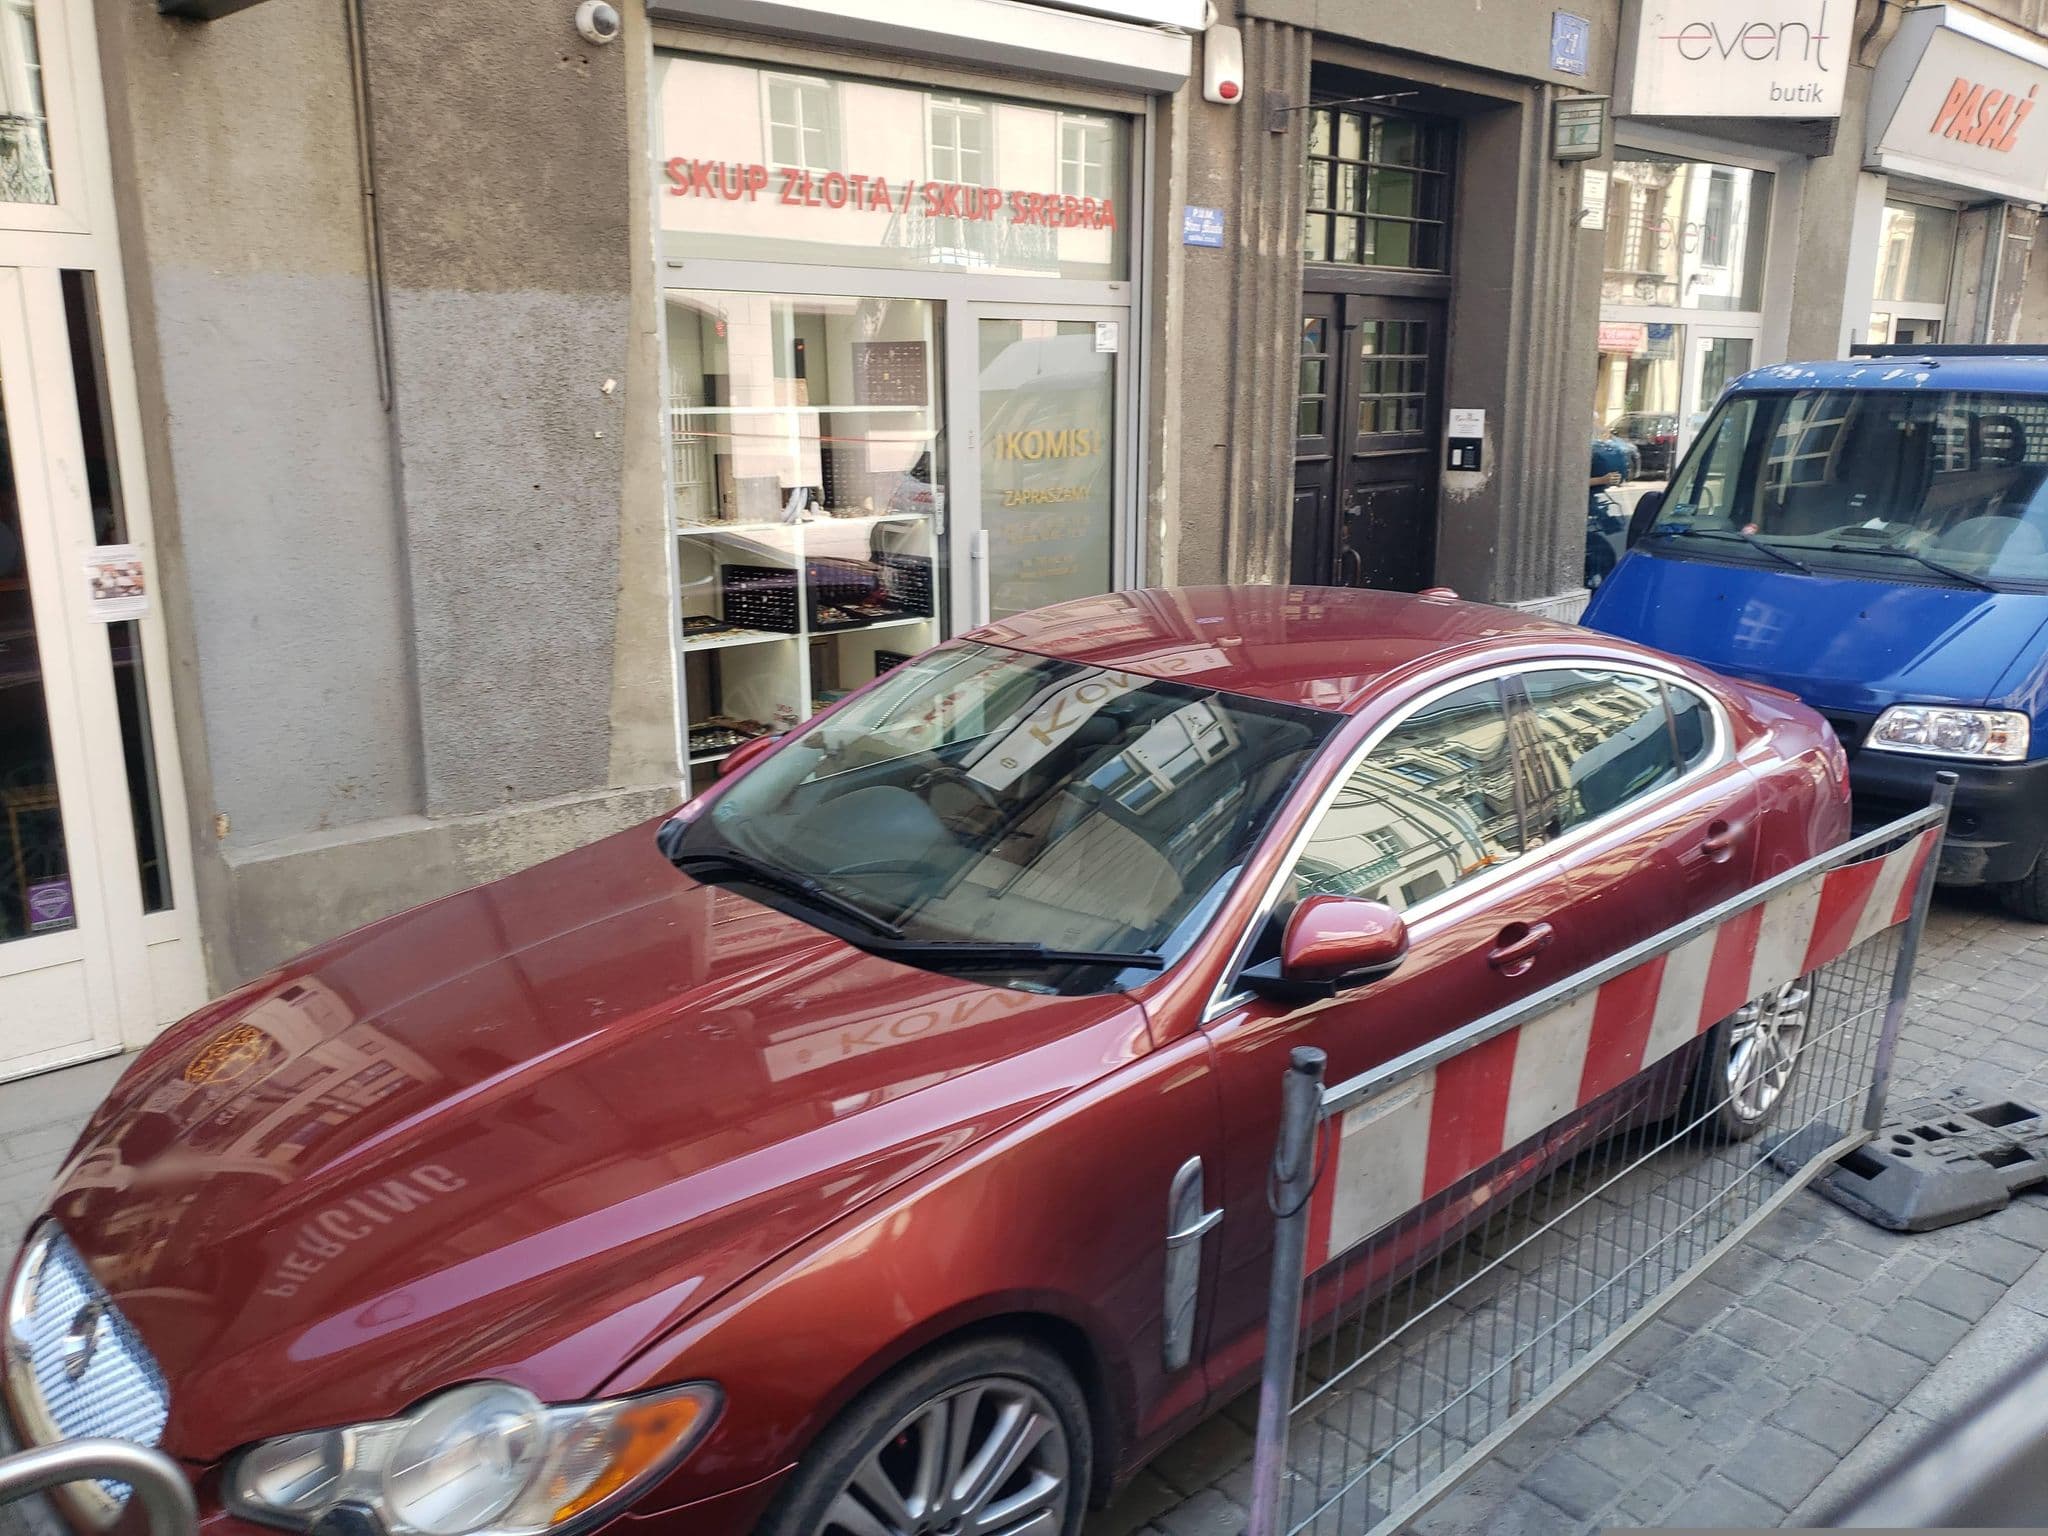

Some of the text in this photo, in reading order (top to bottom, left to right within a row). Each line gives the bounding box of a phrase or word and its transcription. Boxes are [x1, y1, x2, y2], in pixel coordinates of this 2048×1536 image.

[1659, 0, 1830, 72] event
[1768, 81, 1824, 103] butik
[666, 156, 768, 202] SKUP
[779, 167, 893, 213] ZŁOTA
[924, 181, 1002, 221] SKUP
[1011, 189, 1117, 232] SREBRA
